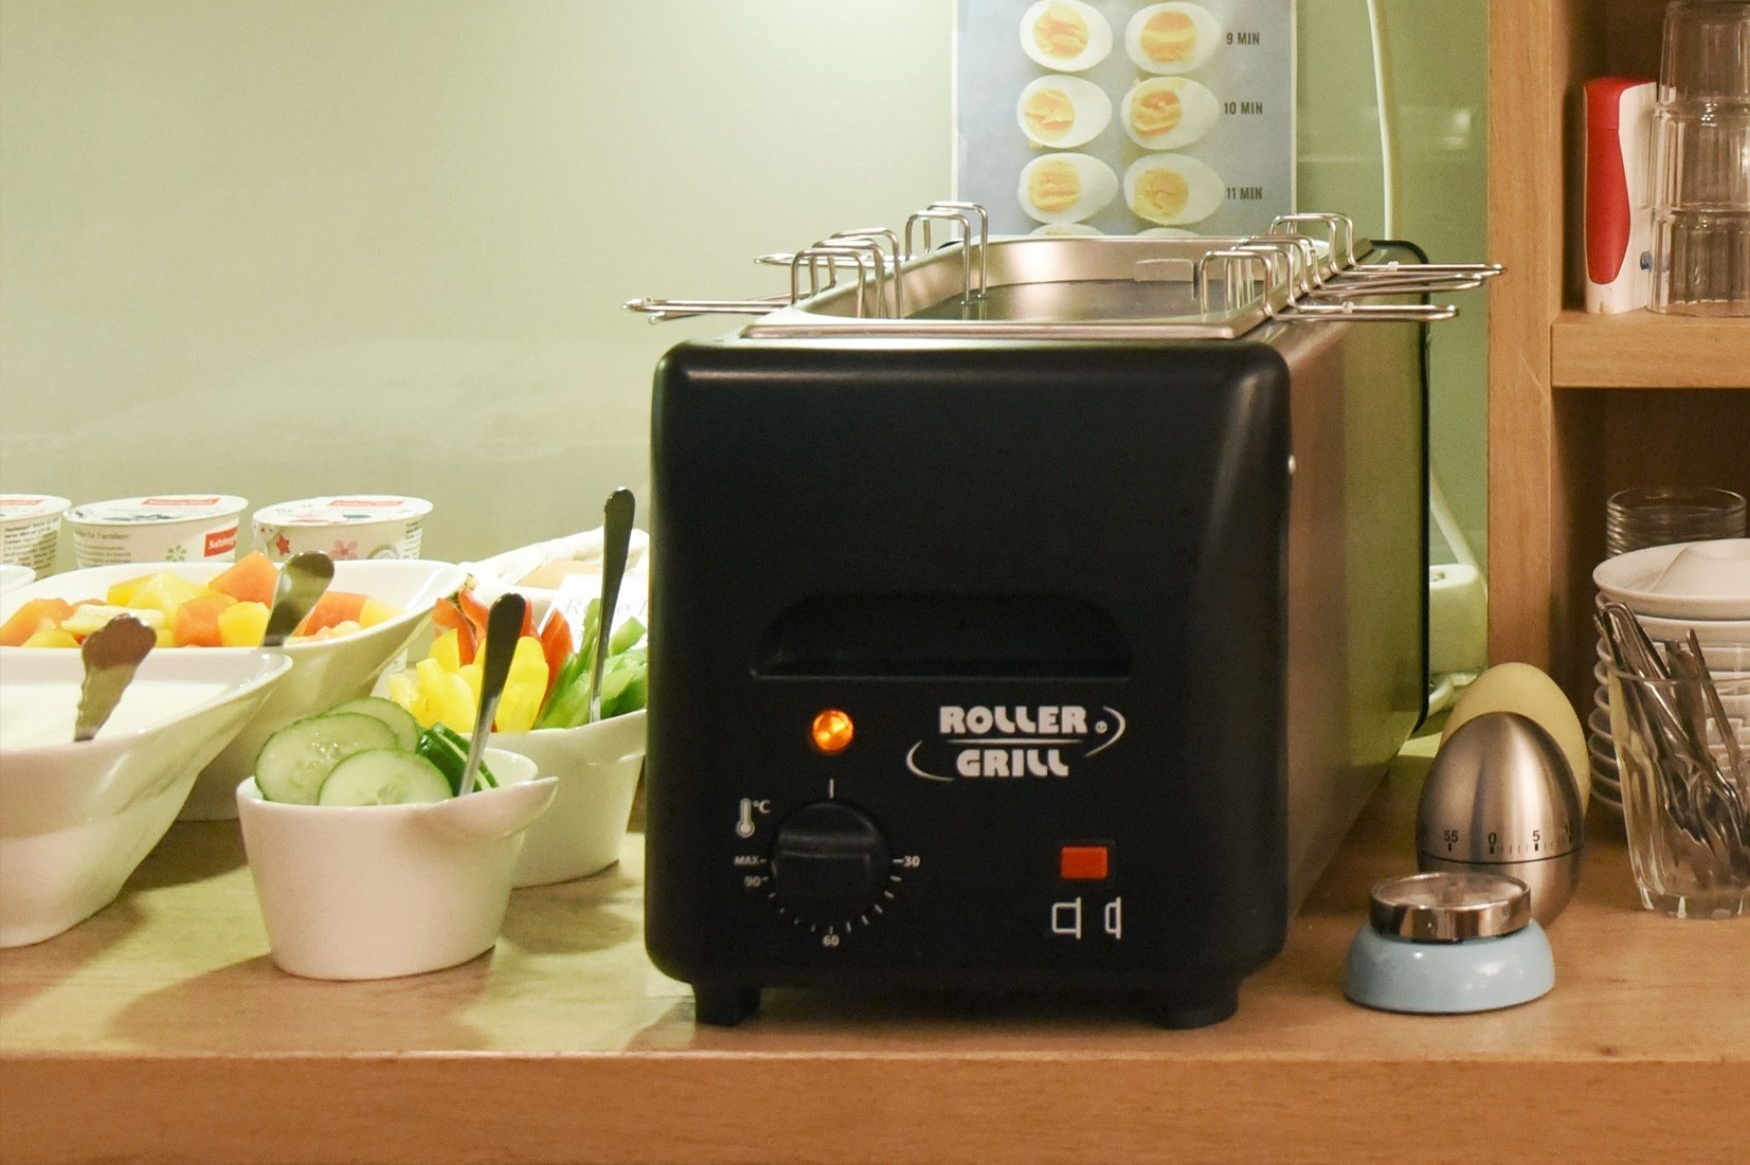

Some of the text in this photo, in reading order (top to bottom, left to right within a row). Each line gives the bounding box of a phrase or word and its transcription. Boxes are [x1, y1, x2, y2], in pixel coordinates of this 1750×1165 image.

[1226, 32, 1260, 46] 9 MIN
[1223, 101, 1264, 116] 10 MIN
[1226, 186, 1263, 201] 11 MIN
[939, 705, 1088, 735] ROLLER
[956, 748, 1070, 778] GRILL
[1443, 829, 1541, 845] 55 0 5
[734, 854, 759, 867] MAX
[903, 854, 921, 868] 30
[744, 875, 761, 889] 90
[822, 933, 840, 947] 60
